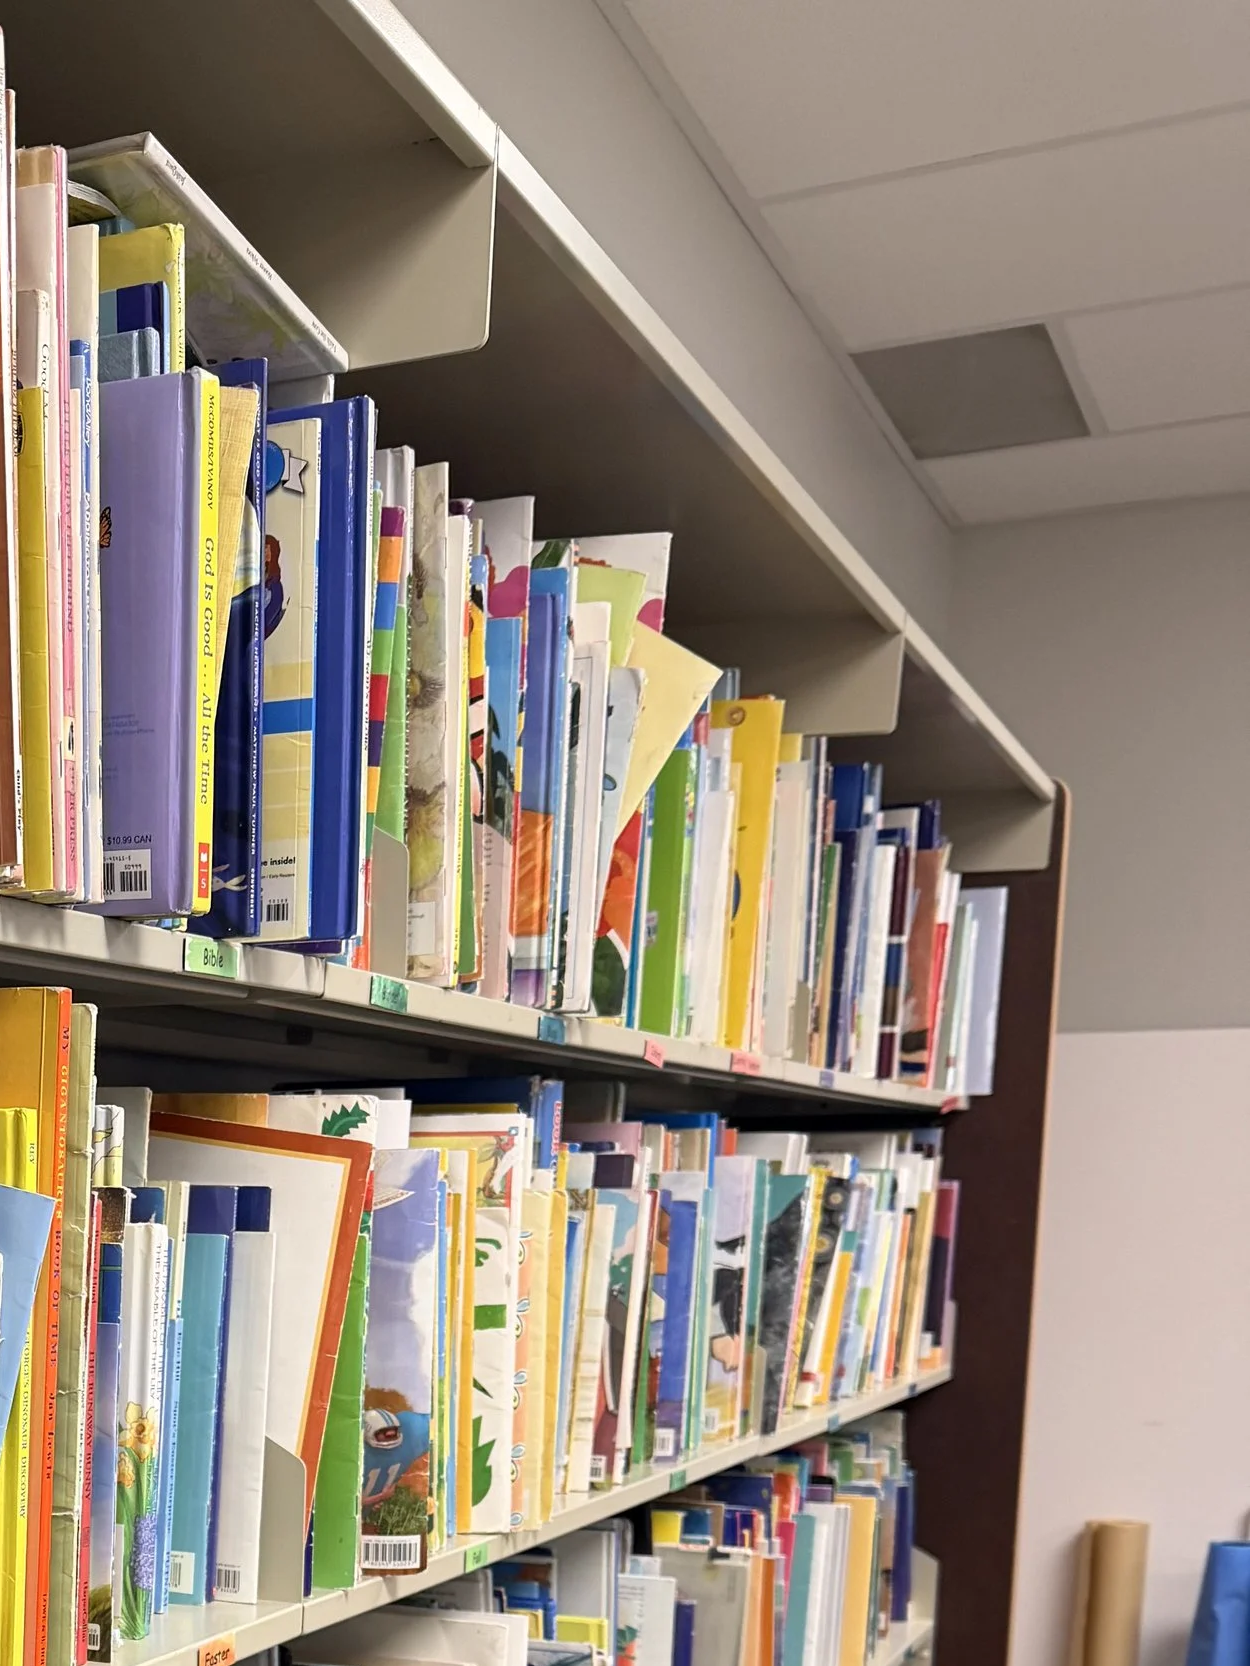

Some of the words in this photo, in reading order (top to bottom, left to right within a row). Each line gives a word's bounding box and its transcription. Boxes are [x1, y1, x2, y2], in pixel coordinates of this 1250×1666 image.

[83, 377, 92, 447] Bond/Alley
[206, 394, 215, 509] McCOMBS/IVANOV
[204, 538, 216, 576] God
[204, 583, 215, 599] Is
[202, 607, 215, 656] Good
[202, 693, 212, 716] All
[201, 725, 212, 752] the
[199, 759, 211, 803] Time
[107, 835, 132, 845] $10.99
[134, 835, 152, 845] CAN
[268, 856, 296, 866] inside!
[203, 947, 224, 968] Bible
[60, 1026, 69, 1053] MY
[55, 1064, 67, 1218] GIGANTOSAURUS
[52, 1230, 62, 1278] BOOK
[51, 1289, 59, 1310] OF
[48, 1322, 58, 1367] TIME
[19, 1391, 30, 1449] DINOSAUR
[85, 1382, 93, 1447] RUNAWAY
[17, 1456, 28, 1517] DISCOVERY
[84, 1452, 92, 1500] BUNNY
